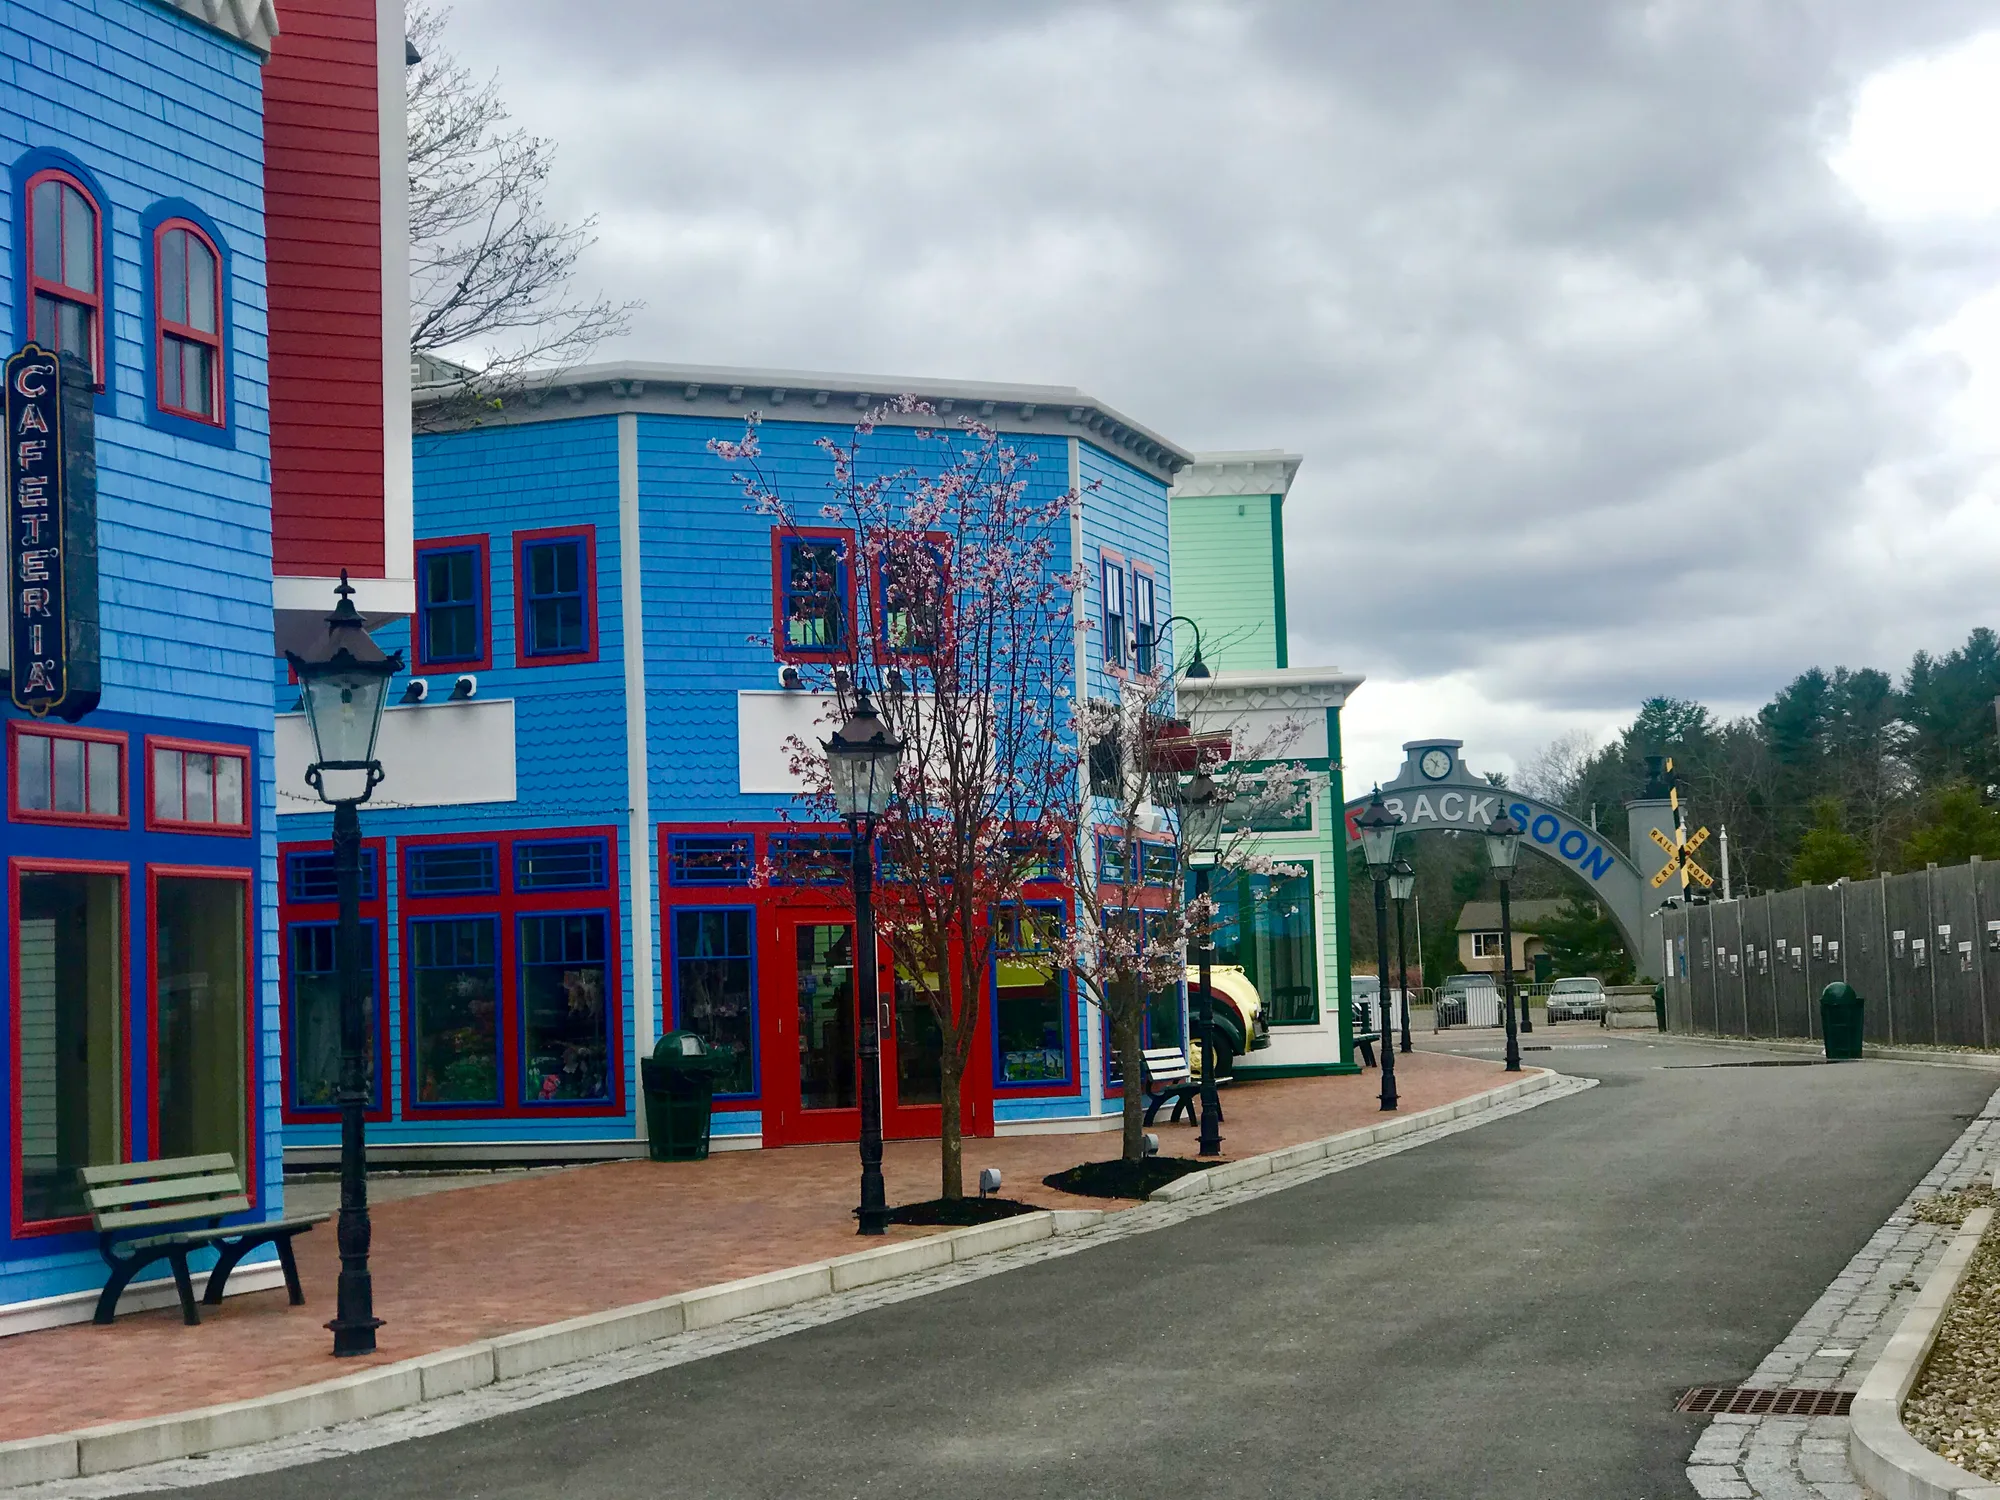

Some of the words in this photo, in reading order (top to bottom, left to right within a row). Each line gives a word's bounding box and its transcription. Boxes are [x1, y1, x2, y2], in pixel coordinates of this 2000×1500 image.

[15, 364, 58, 693] CAFETERIA
[1384, 792, 1495, 825] BACK
[1509, 803, 1614, 880] SOON
[1651, 830, 1672, 852] RAIL
[1687, 863, 1711, 886] ROAD
[1655, 831, 1705, 884] CROSING
